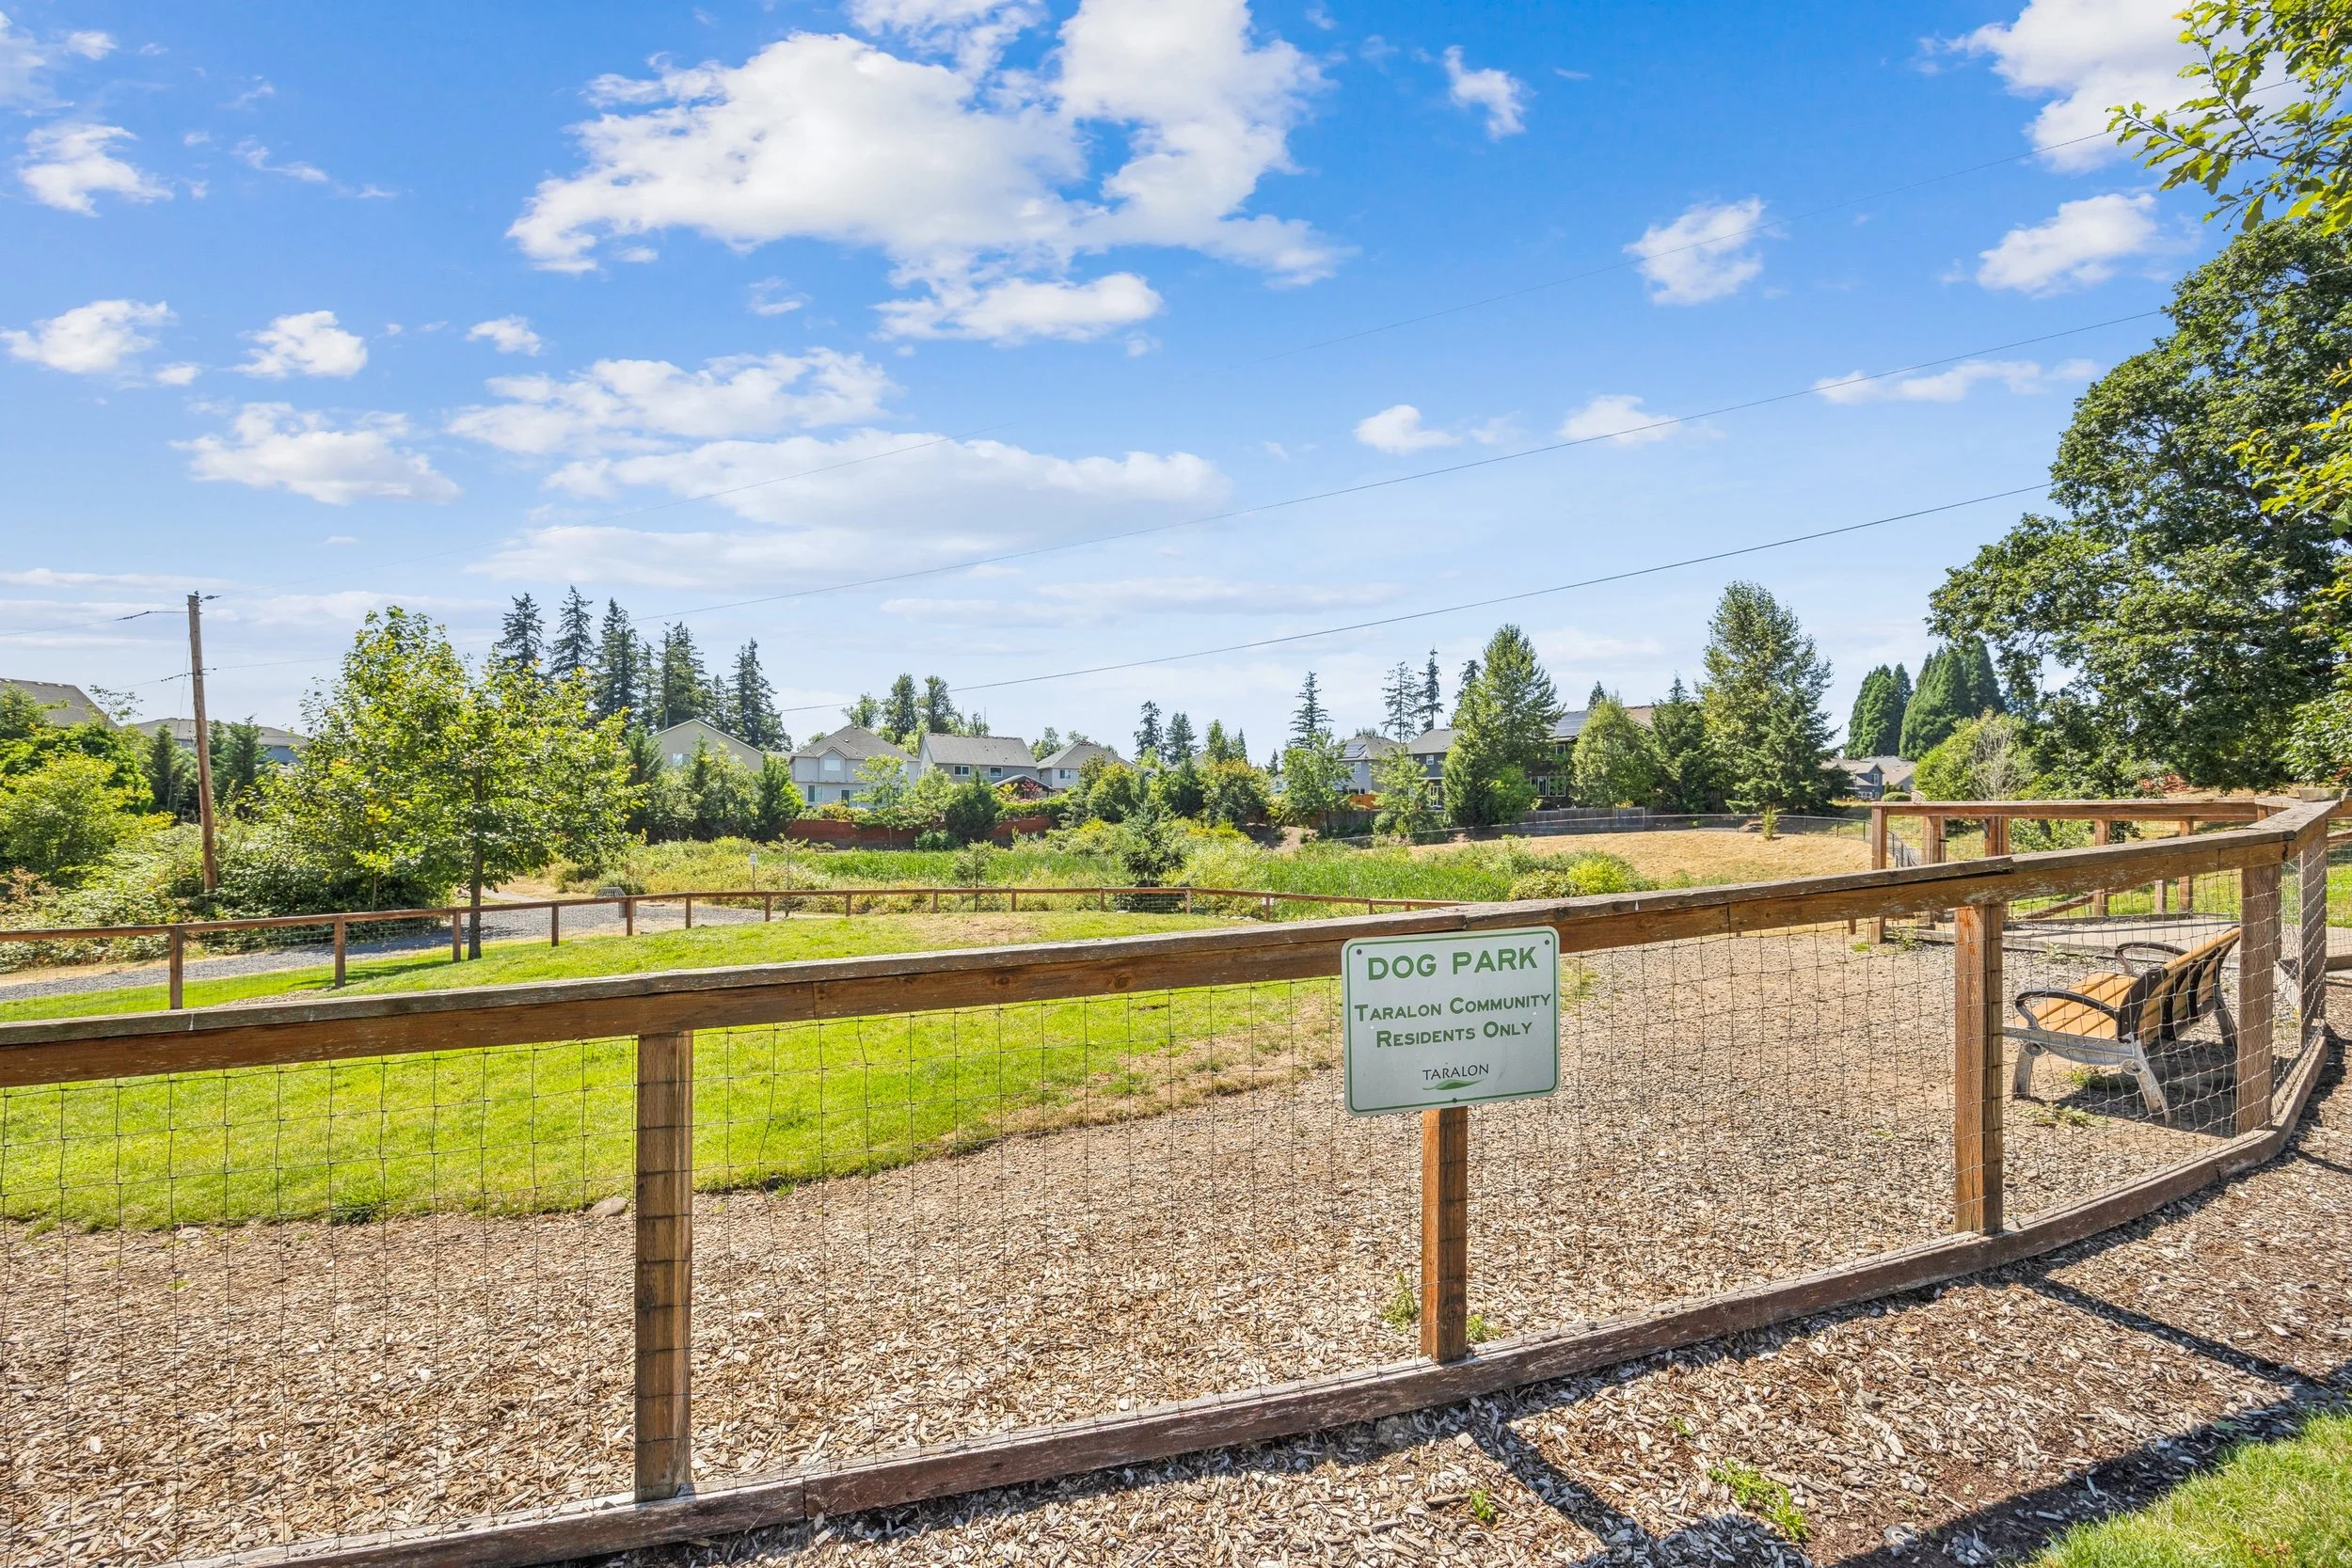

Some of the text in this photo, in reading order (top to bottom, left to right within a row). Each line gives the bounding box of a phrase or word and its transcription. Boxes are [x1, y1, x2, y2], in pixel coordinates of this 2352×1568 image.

[1368, 946, 1537, 980] DOG PARK
[1422, 1064, 1489, 1080] TARALON
